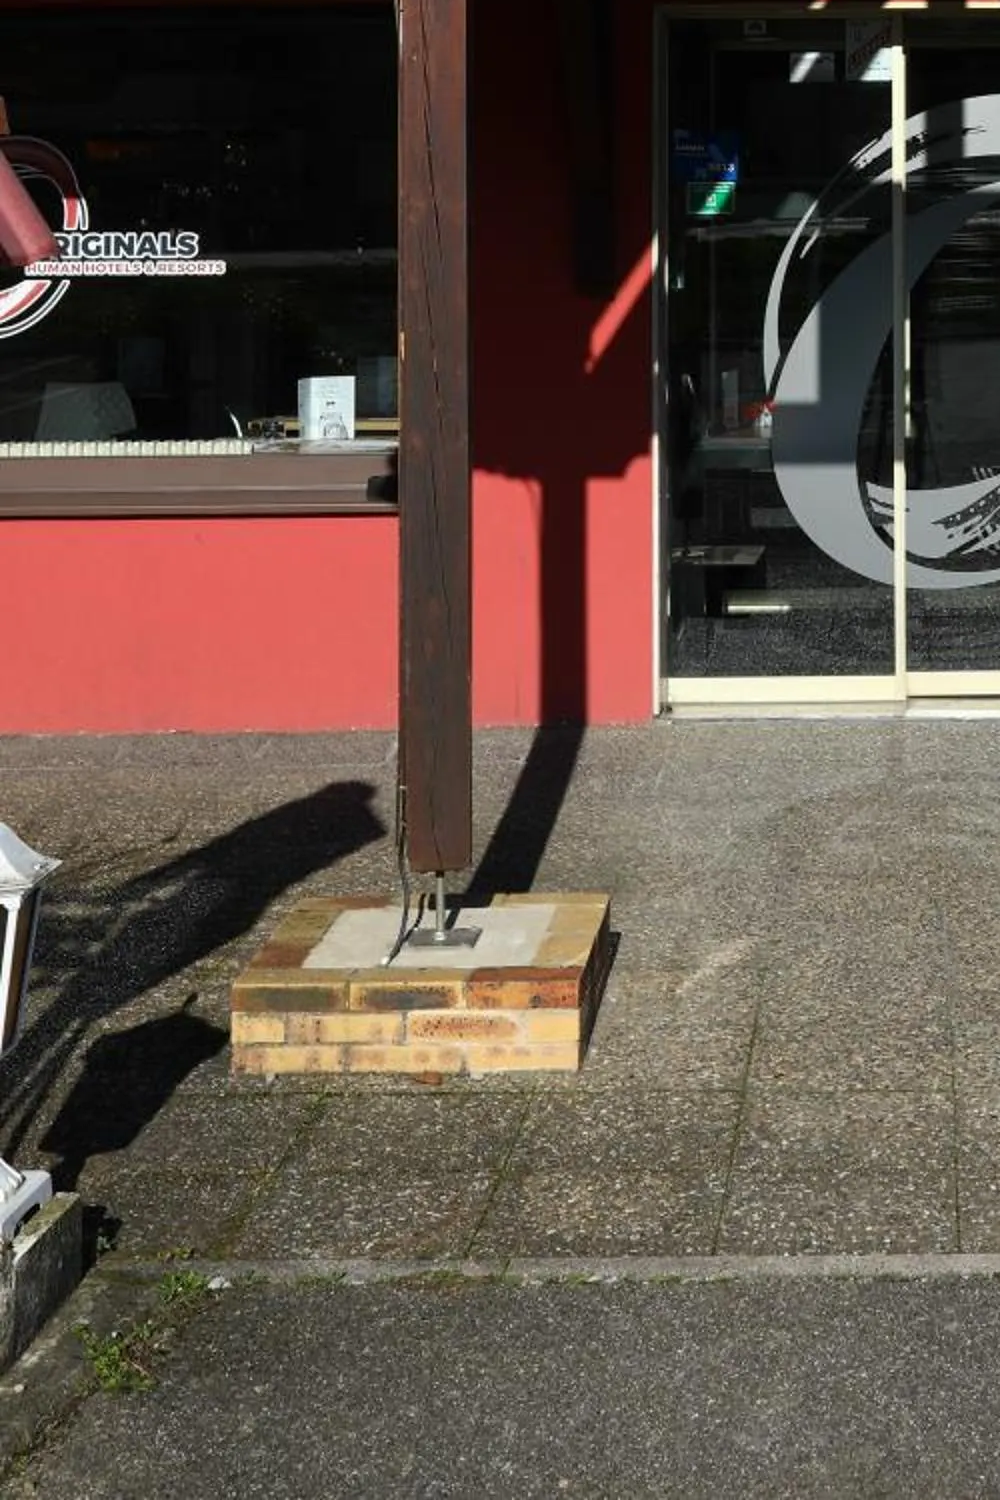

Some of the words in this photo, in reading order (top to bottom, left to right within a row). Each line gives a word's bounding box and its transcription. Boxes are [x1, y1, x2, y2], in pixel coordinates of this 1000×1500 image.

[53, 233, 199, 258] RIGINALS
[25, 261, 83, 275] HUMAN
[84, 261, 142, 275] HOTELS
[144, 261, 156, 275] &
[157, 261, 226, 275] RESORTS
